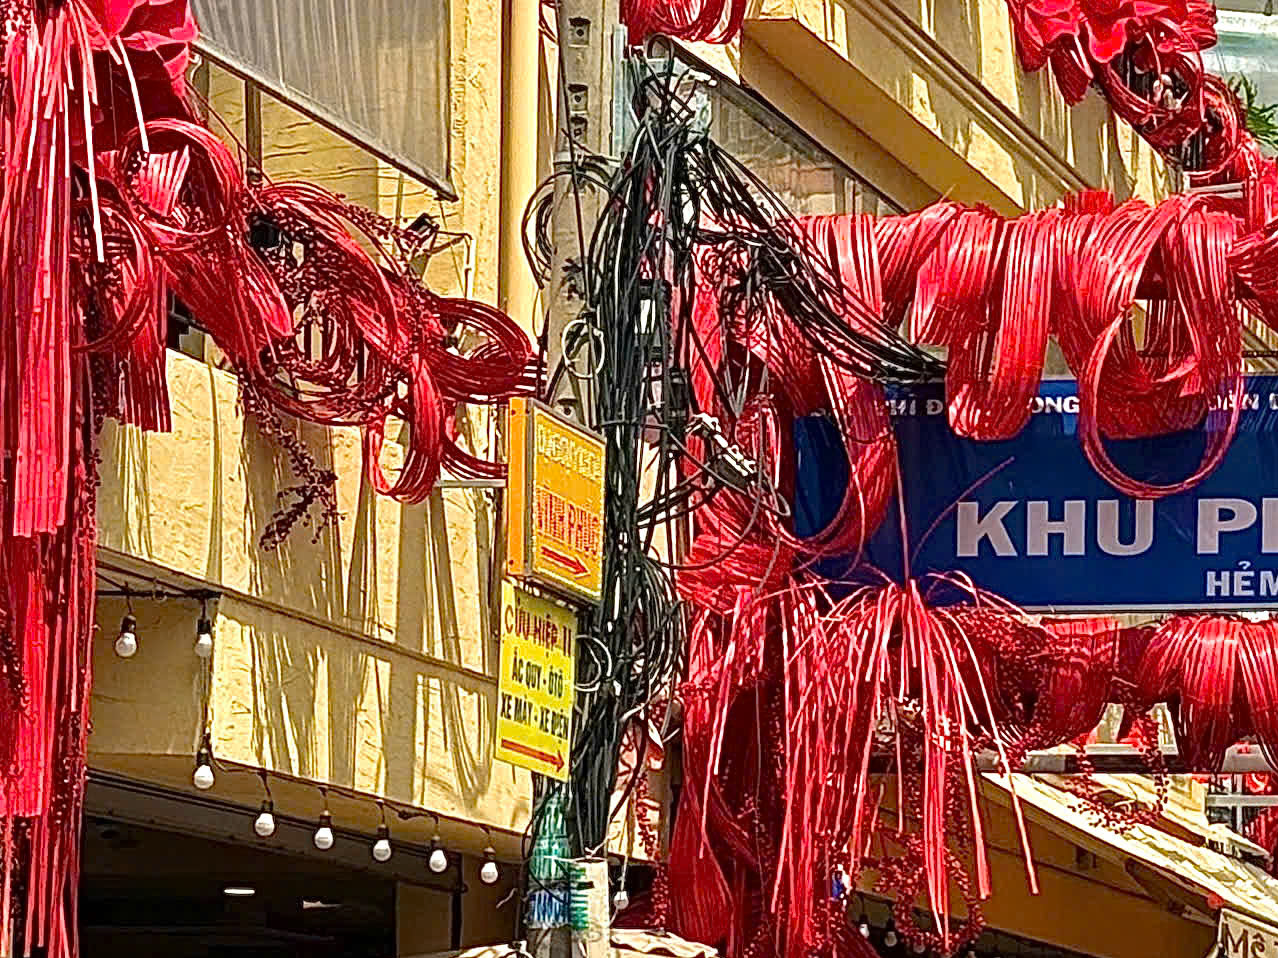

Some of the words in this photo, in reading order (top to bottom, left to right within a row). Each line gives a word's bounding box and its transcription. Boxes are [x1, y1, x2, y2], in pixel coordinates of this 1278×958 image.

[956, 497, 1155, 558] KHU
[525, 660, 542, 691] QUY
[500, 691, 512, 720] XE
[539, 706, 550, 733] XE
